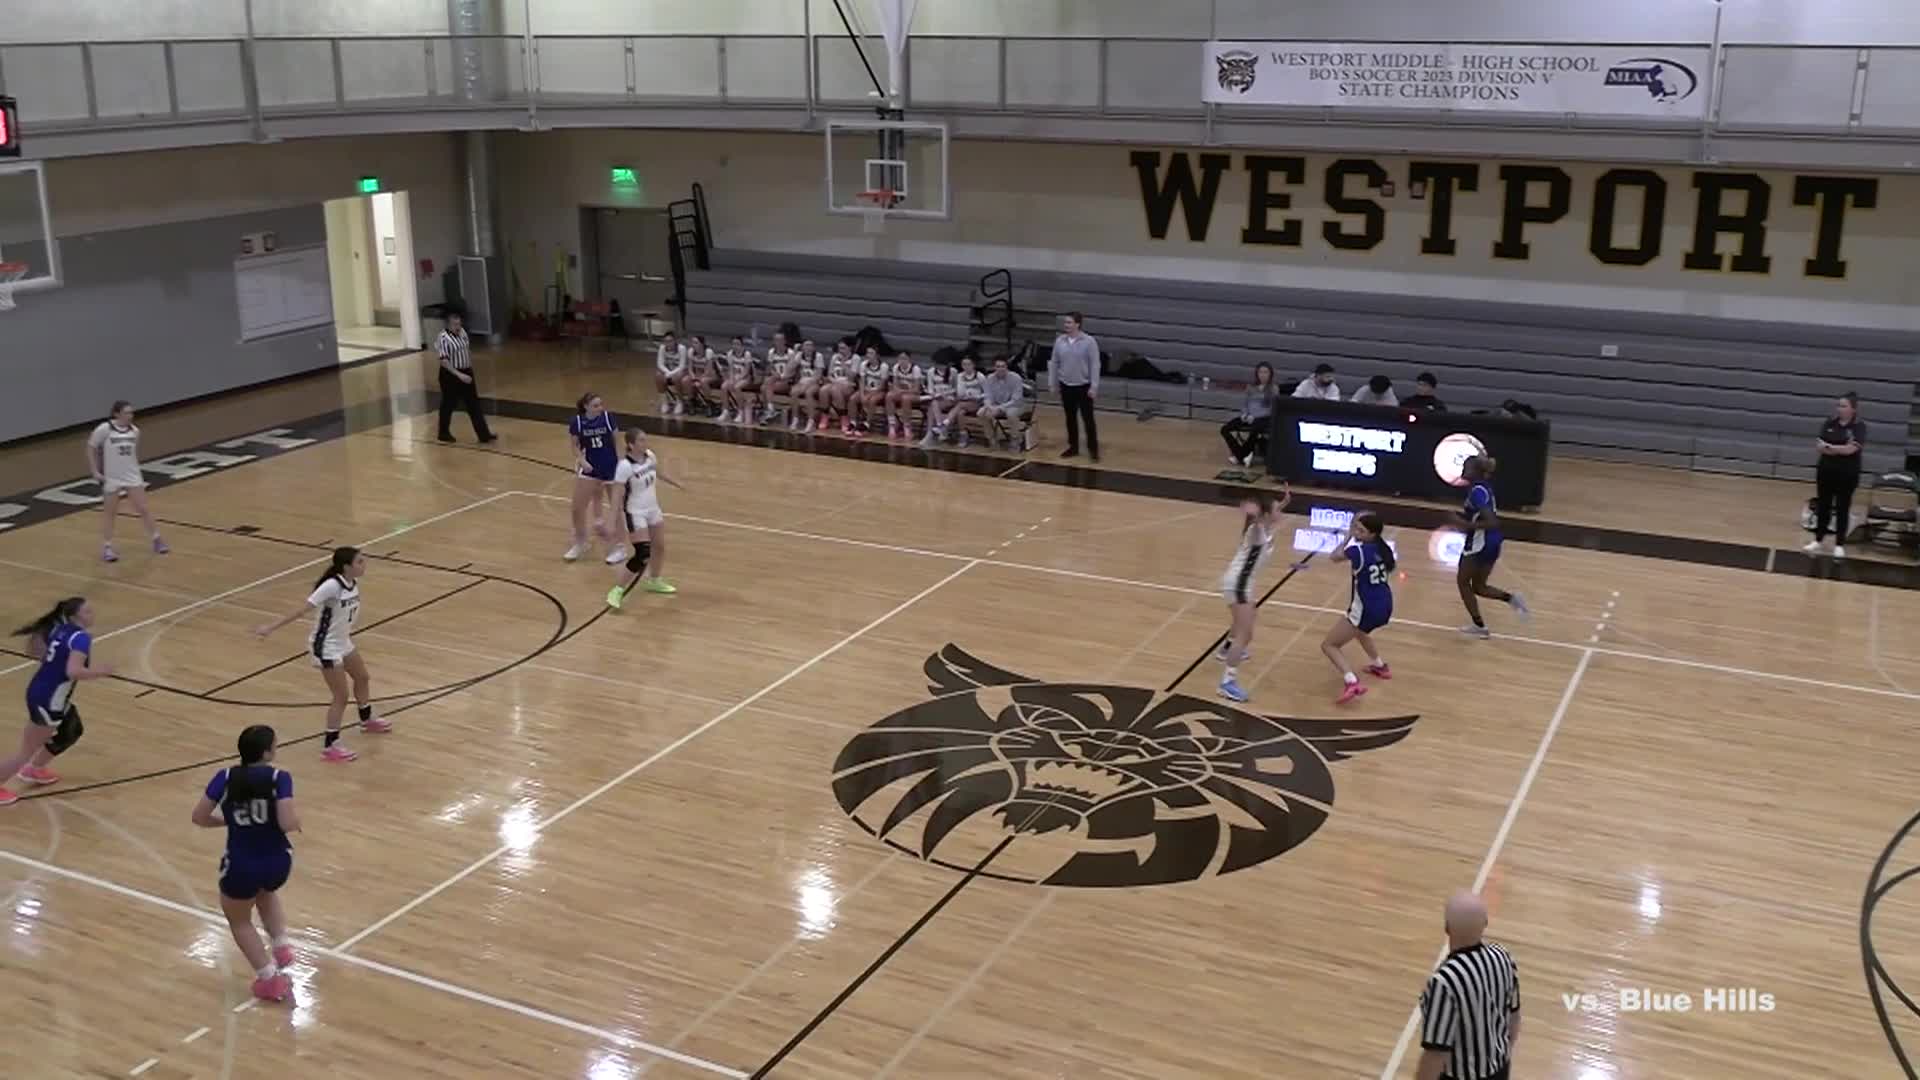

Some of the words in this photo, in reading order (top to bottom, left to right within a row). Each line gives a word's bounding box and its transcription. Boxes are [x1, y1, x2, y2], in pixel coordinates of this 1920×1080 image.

[1272, 51, 1366, 67] WESTPORT
[1372, 54, 1443, 68] MIDDLE
[1463, 55, 1513, 70] HIGH
[1519, 56, 1600, 72] SCHOOL
[1309, 68, 1349, 80] BOYS
[1353, 69, 1417, 82] SOCCER
[1421, 70, 1452, 83] 2023
[1458, 71, 1536, 85] DIVISION
[1542, 74, 1554, 85] V
[1338, 83, 1393, 97] STATE
[1400, 83, 1520, 100] CHAMPIONS
[1130, 150, 1878, 279] WESTPORT
[1369, 563, 1387, 585] 23
[47, 640, 60, 662] 5
[232, 798, 269, 826] 20
